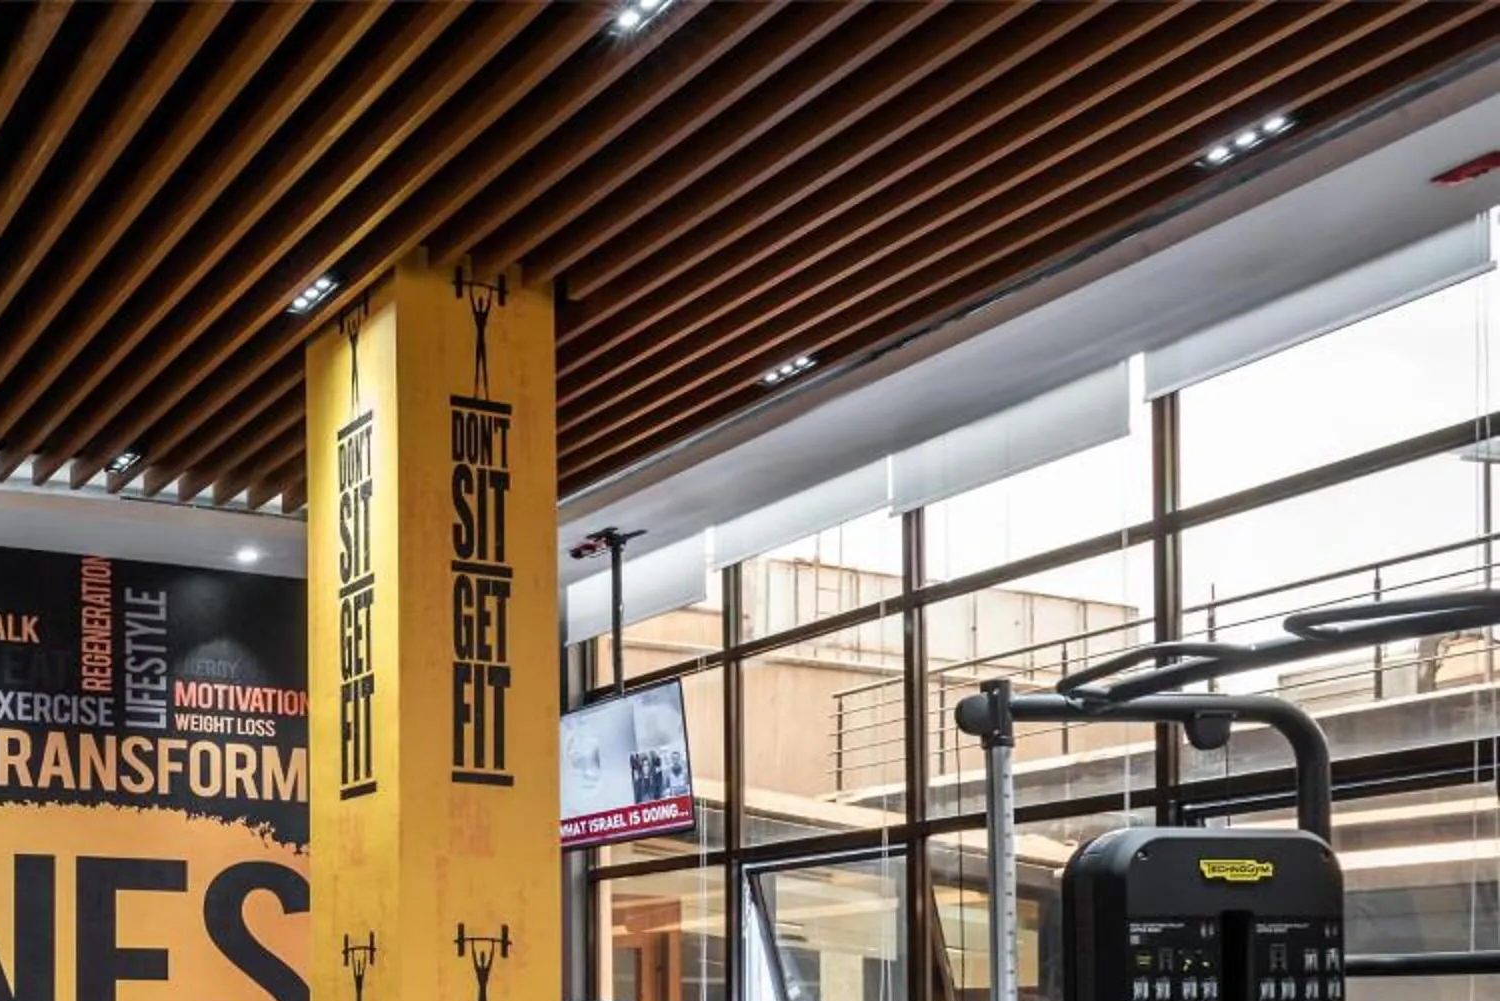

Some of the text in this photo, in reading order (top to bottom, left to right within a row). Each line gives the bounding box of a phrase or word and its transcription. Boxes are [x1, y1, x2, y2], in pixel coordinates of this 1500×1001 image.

[339, 425, 373, 493] DON'T
[452, 408, 510, 470] DON'T
[339, 478, 373, 584] SIT
[452, 464, 510, 562] SIT
[81, 556, 112, 693] REGENERATION
[125, 587, 168, 730] LIFESTYLE
[340, 588, 374, 682] GET
[453, 575, 510, 663] GET
[175, 713, 277, 737] WEIGHT LOSS
[340, 672, 375, 786] FIT
[452, 661, 511, 771] FIT
[589, 813, 627, 833] ISRAEL
[629, 811, 641, 825] IS
